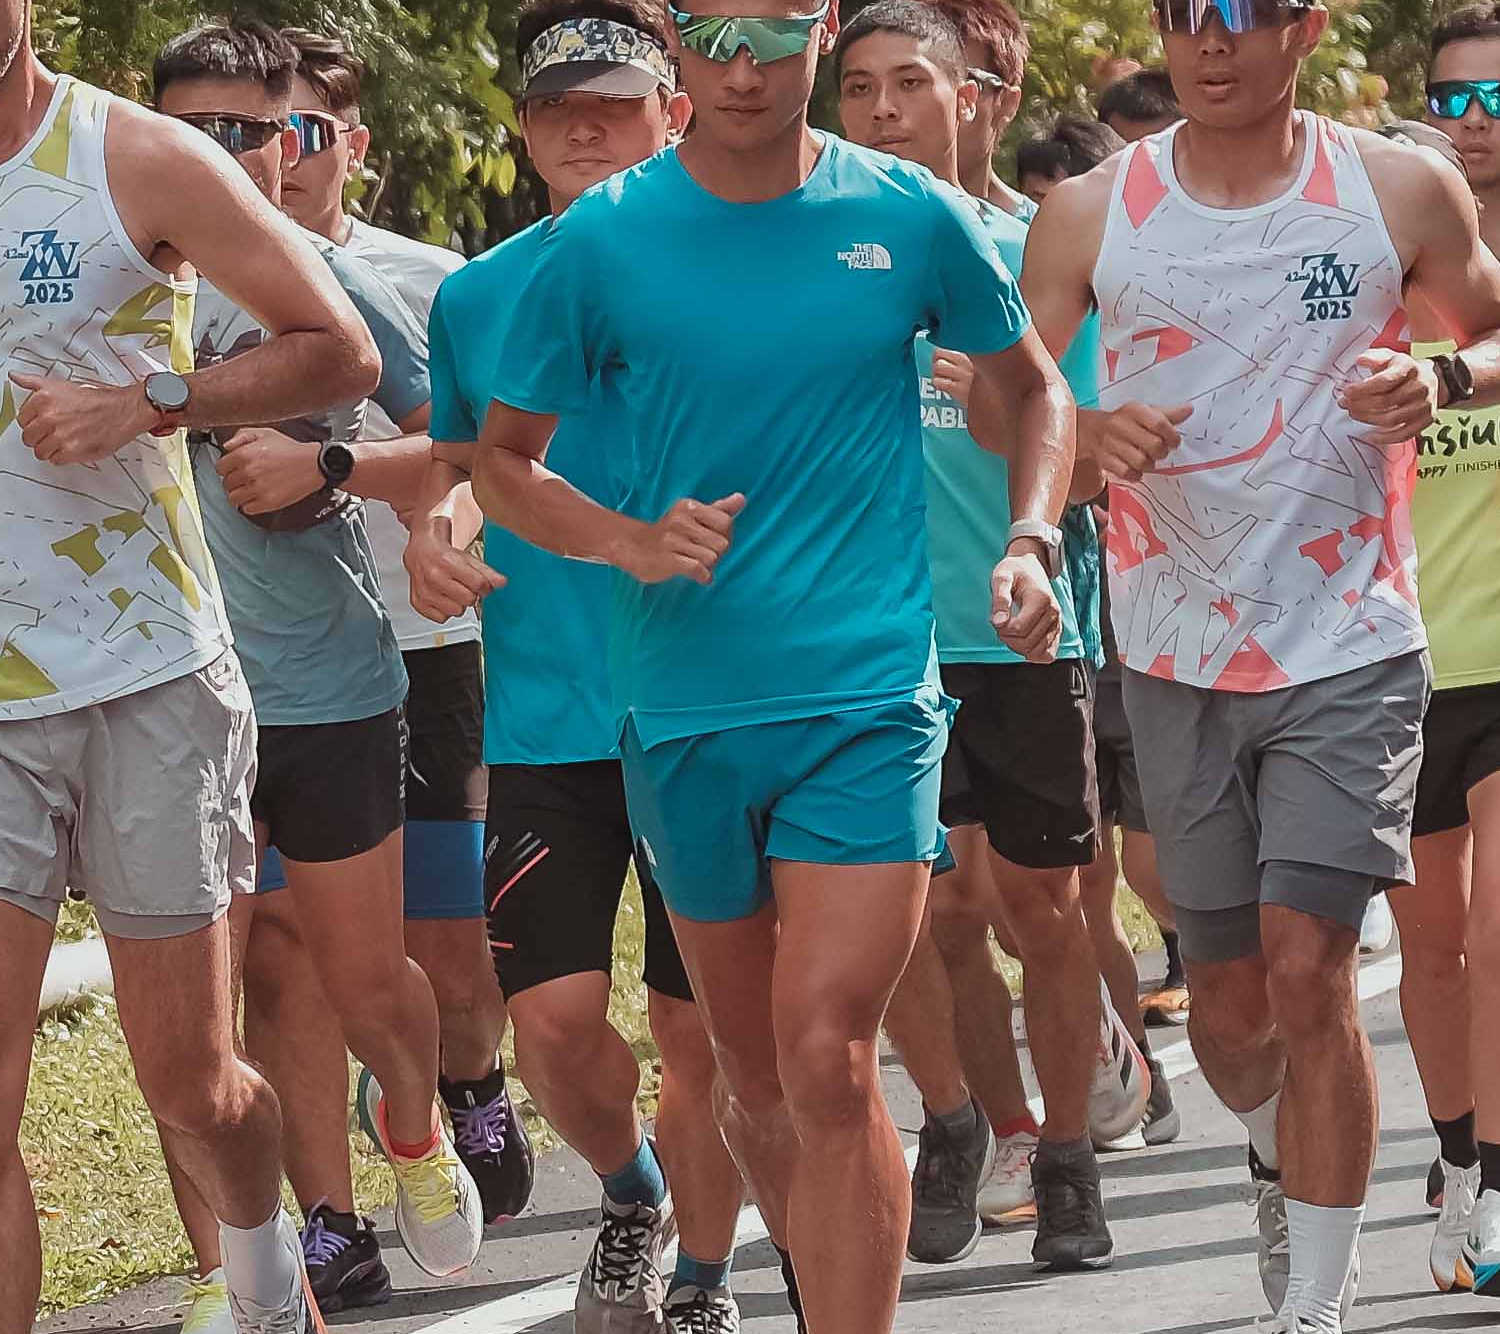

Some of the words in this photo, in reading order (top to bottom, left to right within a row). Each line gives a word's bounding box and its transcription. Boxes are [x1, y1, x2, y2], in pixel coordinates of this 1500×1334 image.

[852, 243, 872, 252] THE
[837, 251, 872, 261] NORTH
[847, 259, 872, 269] FACE
[23, 282, 74, 304] 2025
[1305, 300, 1352, 322] 2025
